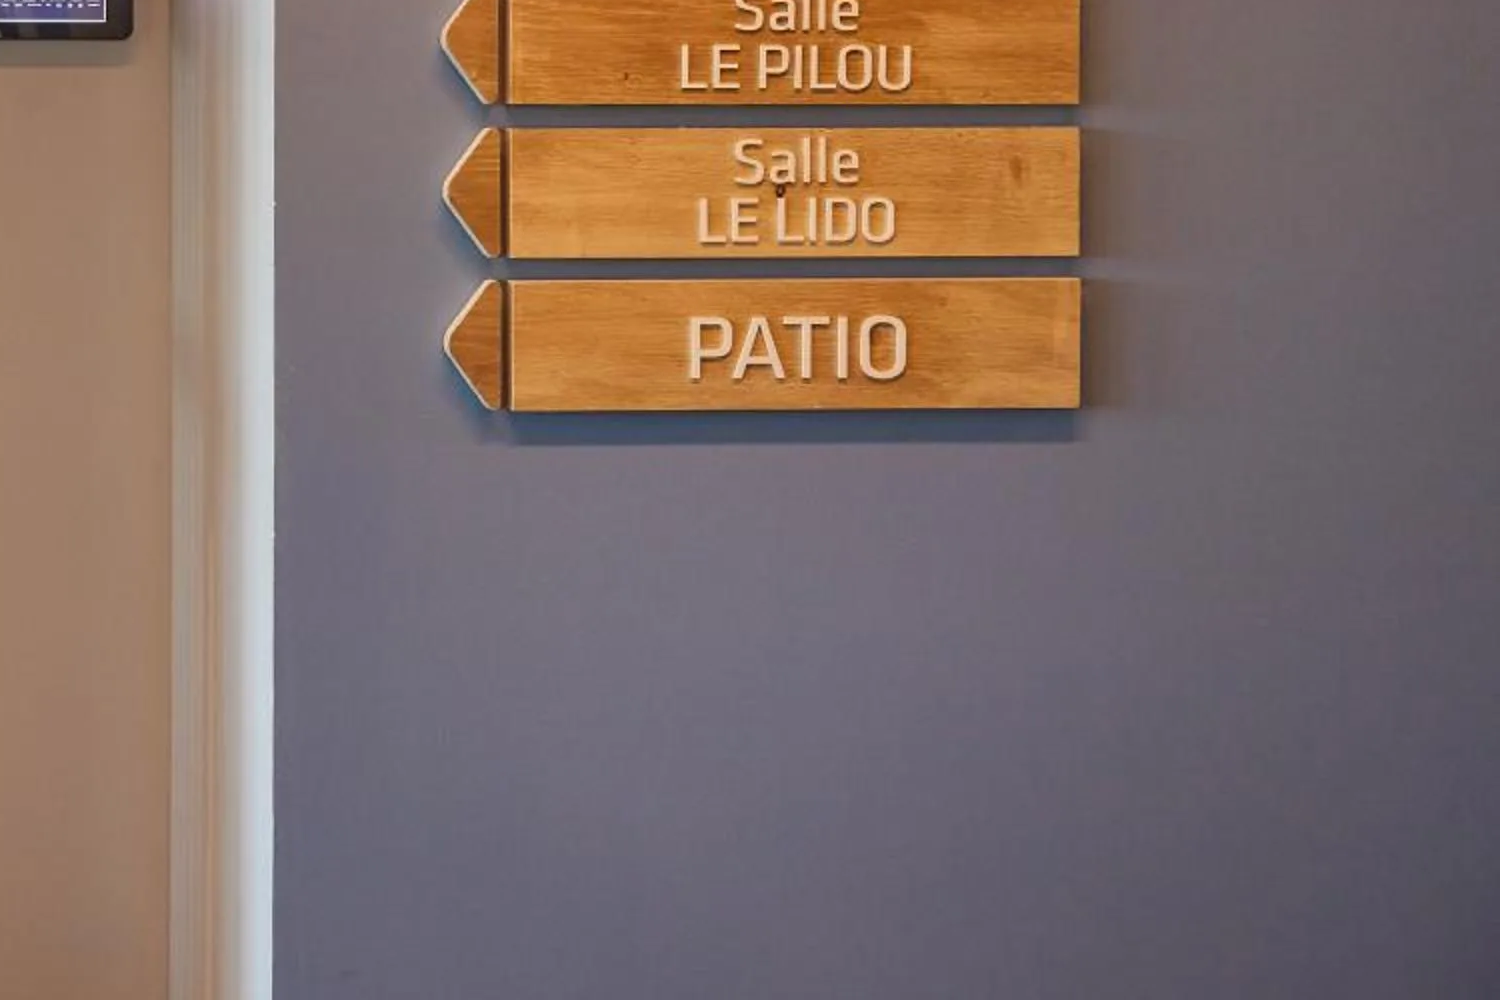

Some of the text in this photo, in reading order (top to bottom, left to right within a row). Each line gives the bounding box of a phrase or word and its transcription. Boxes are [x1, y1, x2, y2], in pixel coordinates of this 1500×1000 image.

[680, 44, 911, 90] LE PILOU
[732, 136, 859, 184] Salle
[697, 196, 895, 243] LE LIDO
[687, 314, 907, 379] PATIO
